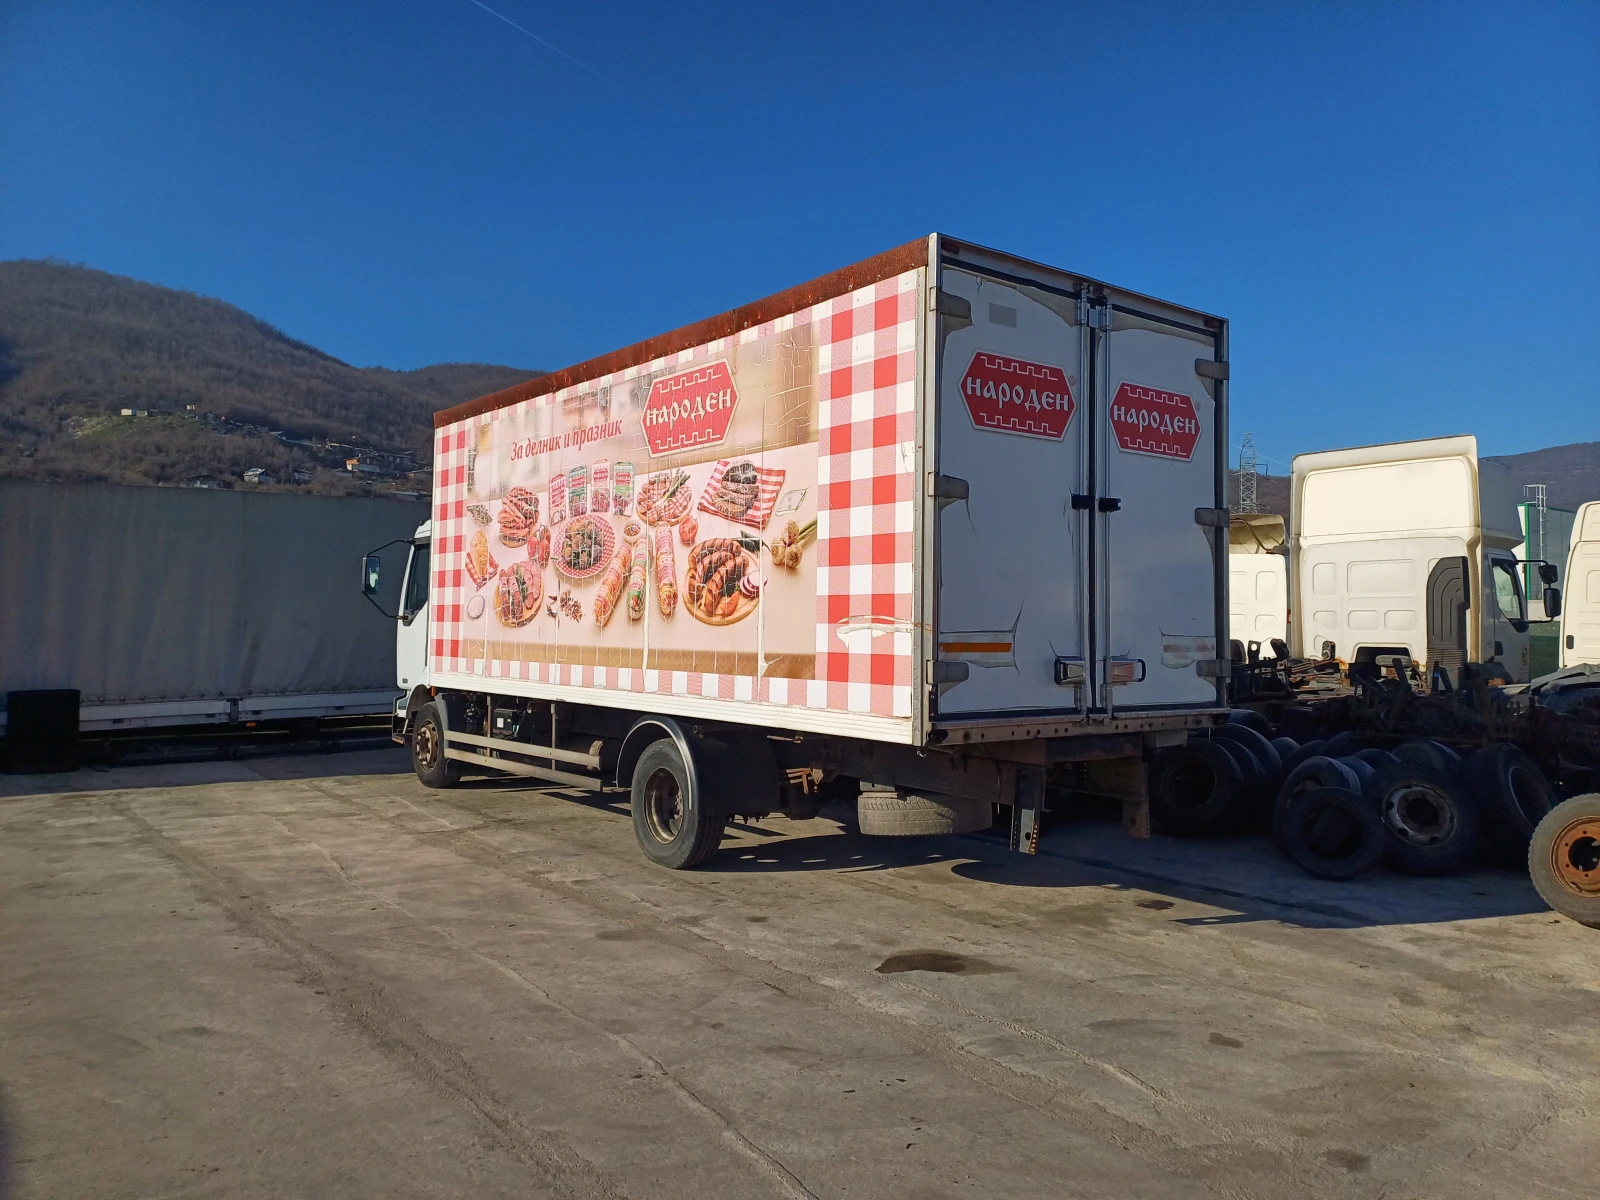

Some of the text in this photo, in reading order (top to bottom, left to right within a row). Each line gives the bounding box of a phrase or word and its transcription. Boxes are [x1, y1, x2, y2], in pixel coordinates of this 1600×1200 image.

[510, 420, 622, 461] За делник и празник
